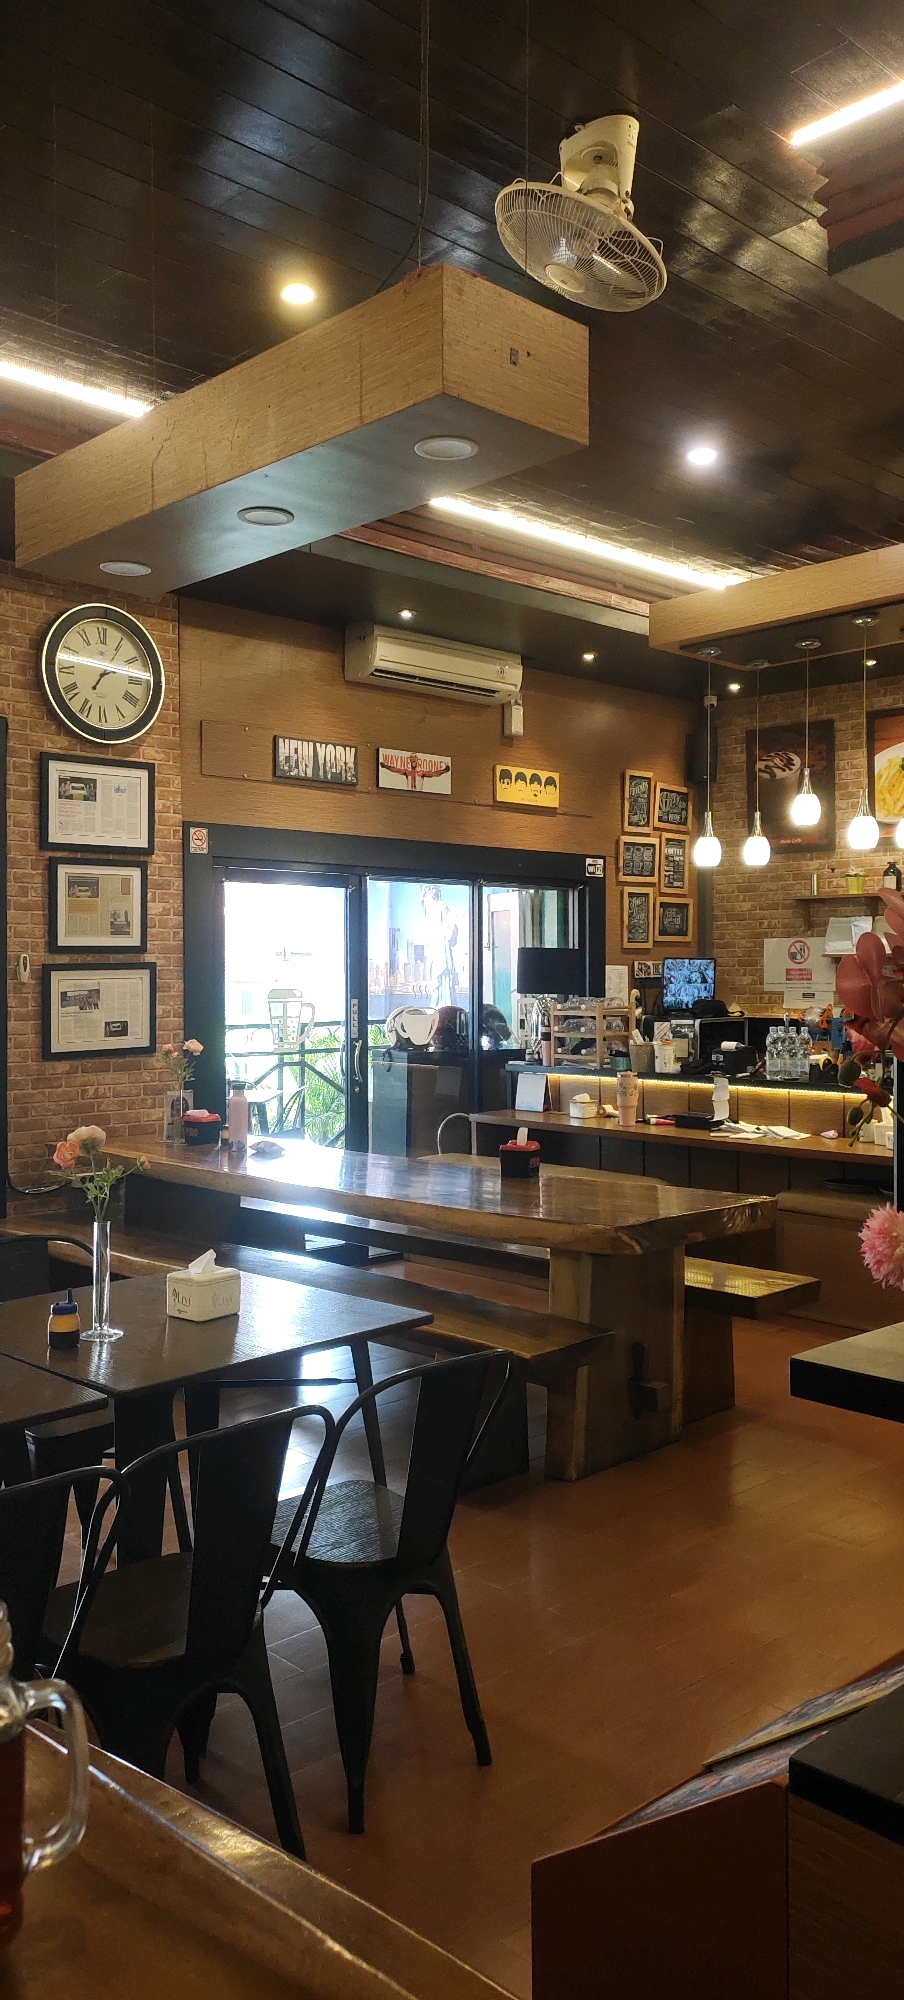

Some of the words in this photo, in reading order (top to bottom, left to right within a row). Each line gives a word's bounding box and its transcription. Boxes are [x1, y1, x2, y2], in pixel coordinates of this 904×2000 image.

[278, 737, 314, 778] NEW
[316, 742, 357, 783] YORK
[382, 752, 411, 770] WAYNE
